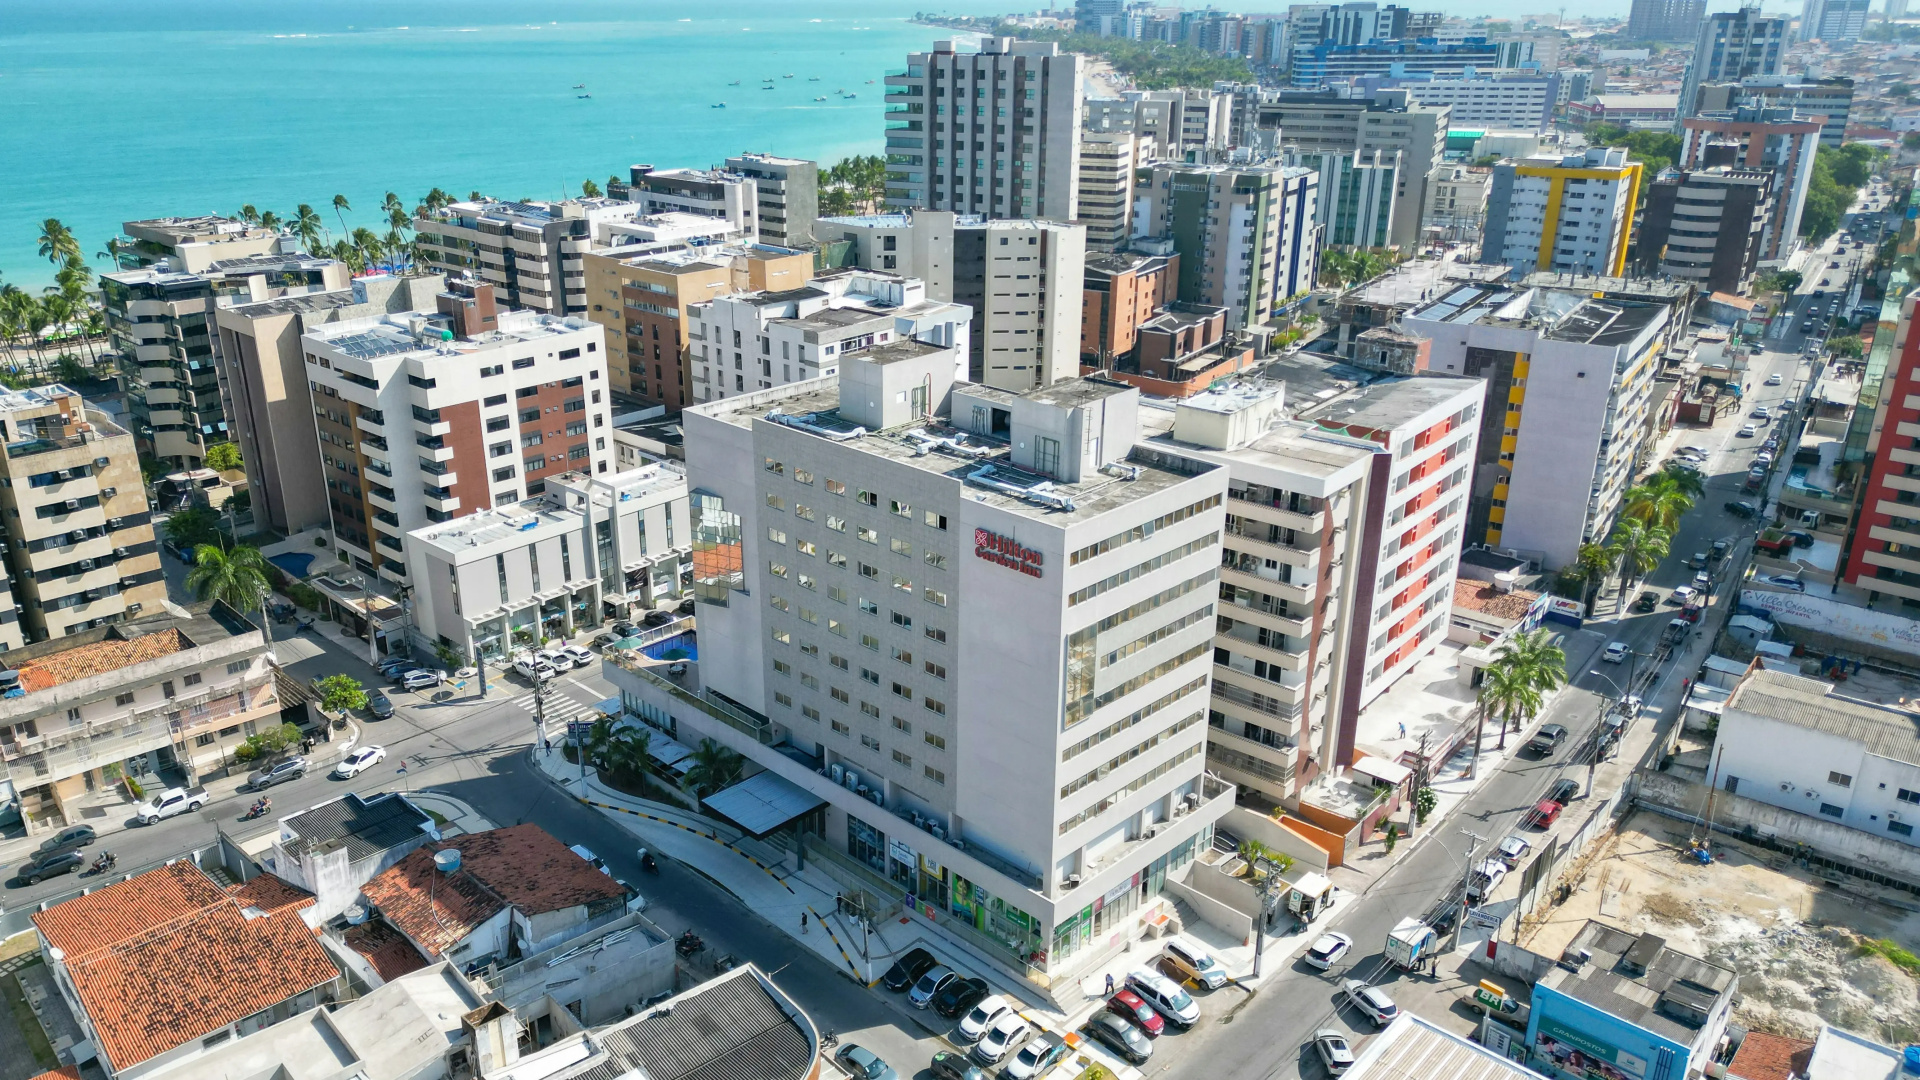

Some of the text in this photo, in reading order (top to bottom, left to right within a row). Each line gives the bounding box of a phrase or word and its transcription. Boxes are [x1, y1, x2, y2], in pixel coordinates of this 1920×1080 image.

[975, 546, 1042, 579] Garden Inn
[989, 533, 1042, 566] Hilton
[1754, 592, 1822, 617] Villa Crescer
[1469, 910, 1498, 923] LAVANDERIA
[1479, 990, 1500, 1006] BR
[1552, 1026, 1608, 1055] GRANPOSTOS
